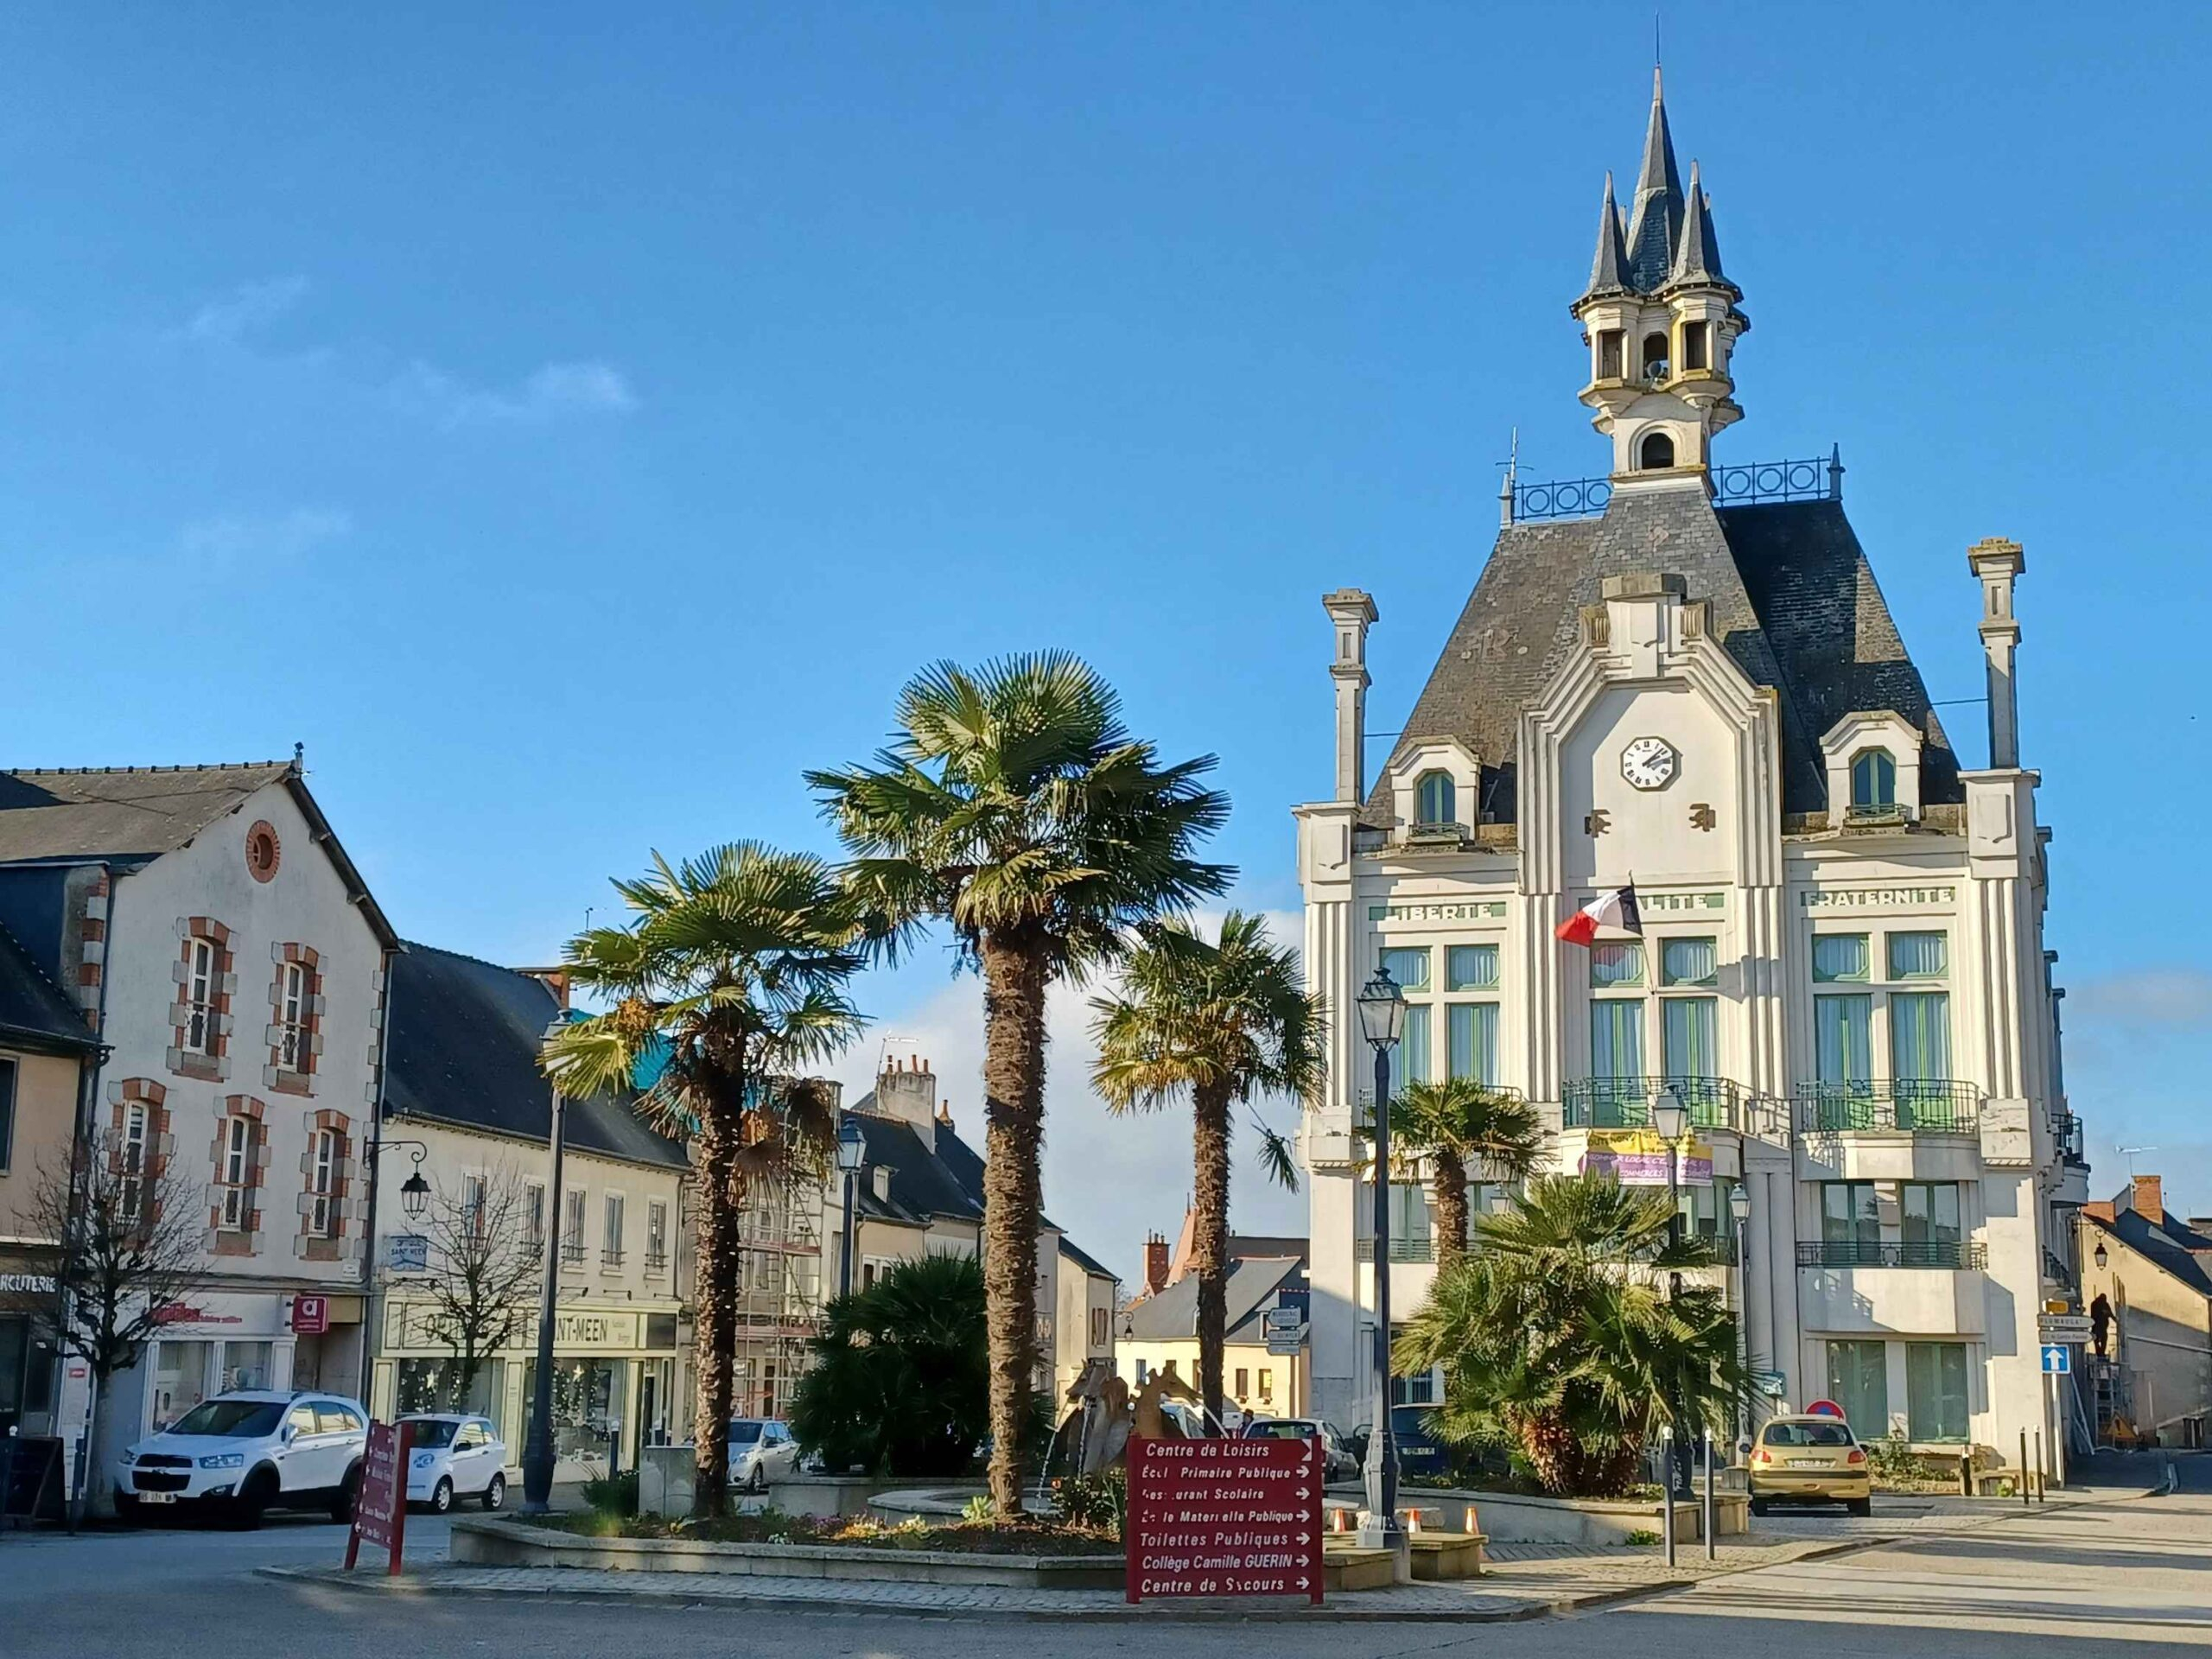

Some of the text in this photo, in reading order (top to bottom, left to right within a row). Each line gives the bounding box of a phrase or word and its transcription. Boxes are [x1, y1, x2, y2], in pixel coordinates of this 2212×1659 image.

[1146, 1442, 1269, 1457] Centre de Loisirs
[1180, 1466, 1232, 1478] Primaire
[1237, 1466, 1291, 1481] Publique
[1214, 1488, 1264, 1500] Scolaire
[1248, 1510, 1294, 1524] Publique
[1141, 1531, 1287, 1549] Toilettes Publiques
[1142, 1554, 1293, 1573] Collège Camille GUERIN
[1141, 1579, 1192, 1593] Centre
[1199, 1578, 1217, 1592] de
